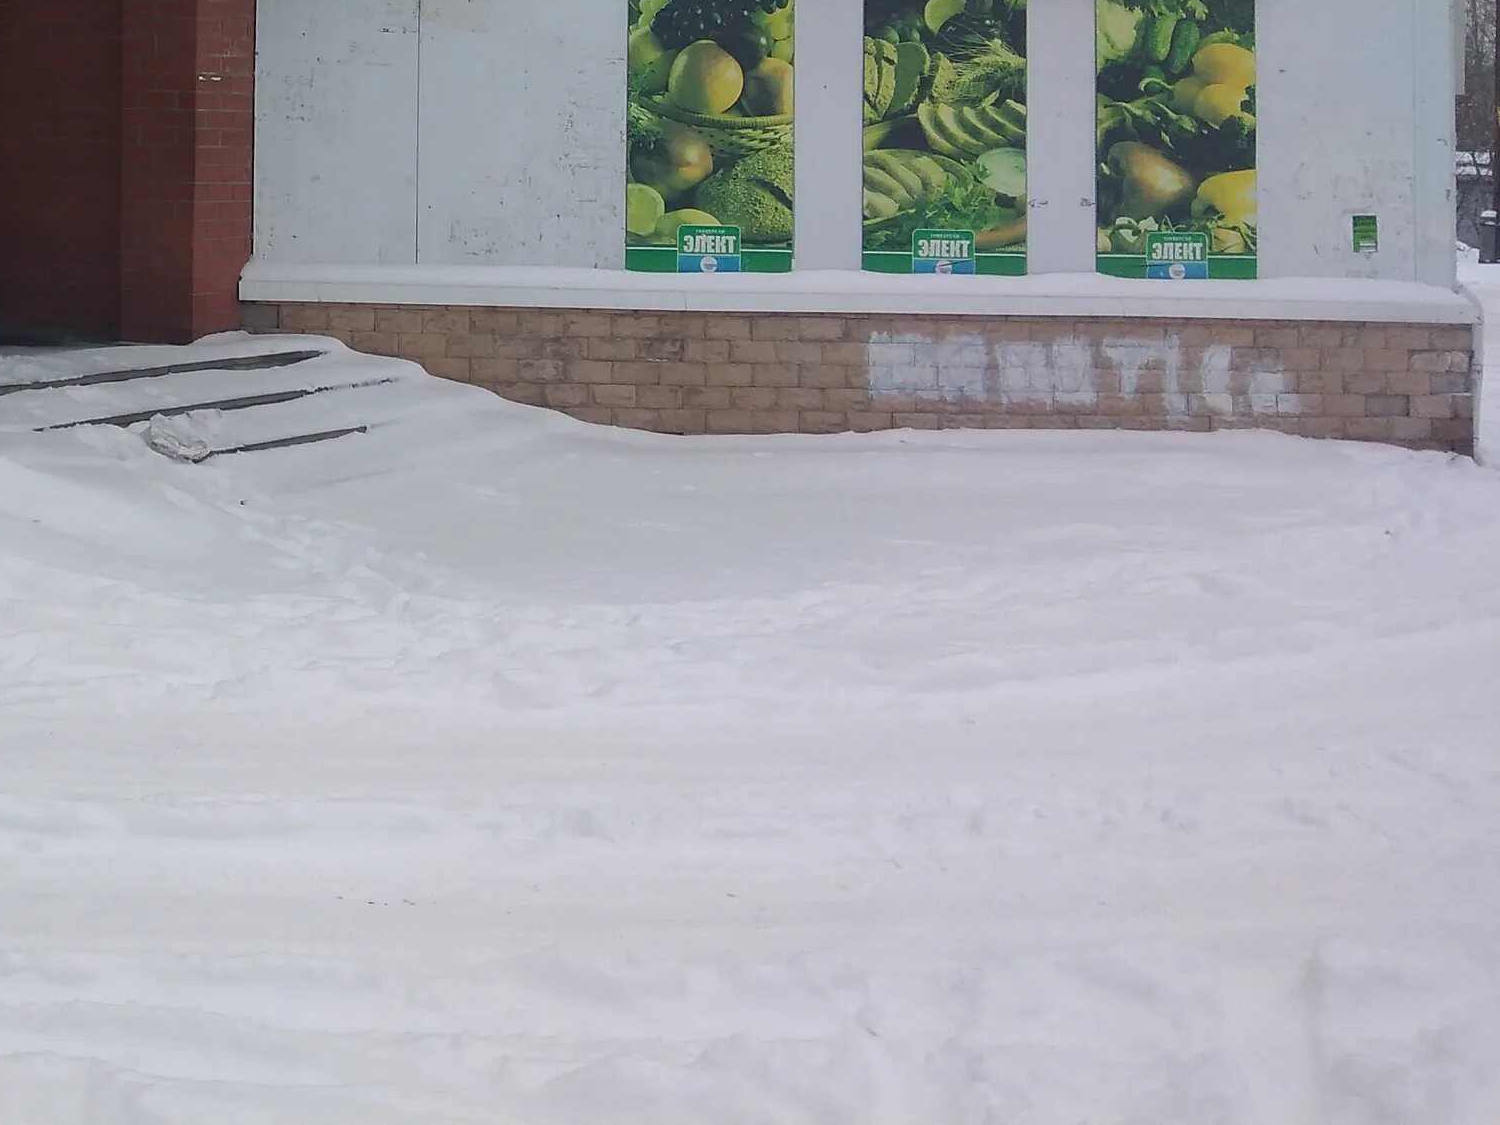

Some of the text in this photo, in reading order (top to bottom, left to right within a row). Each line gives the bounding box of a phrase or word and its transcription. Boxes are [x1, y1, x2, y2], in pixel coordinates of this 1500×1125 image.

[683, 234, 737, 253] ЭЛЕКТ
[918, 239, 970, 258] ЭЛЕКТ
[1152, 242, 1203, 261] ЭЛЕКТ
